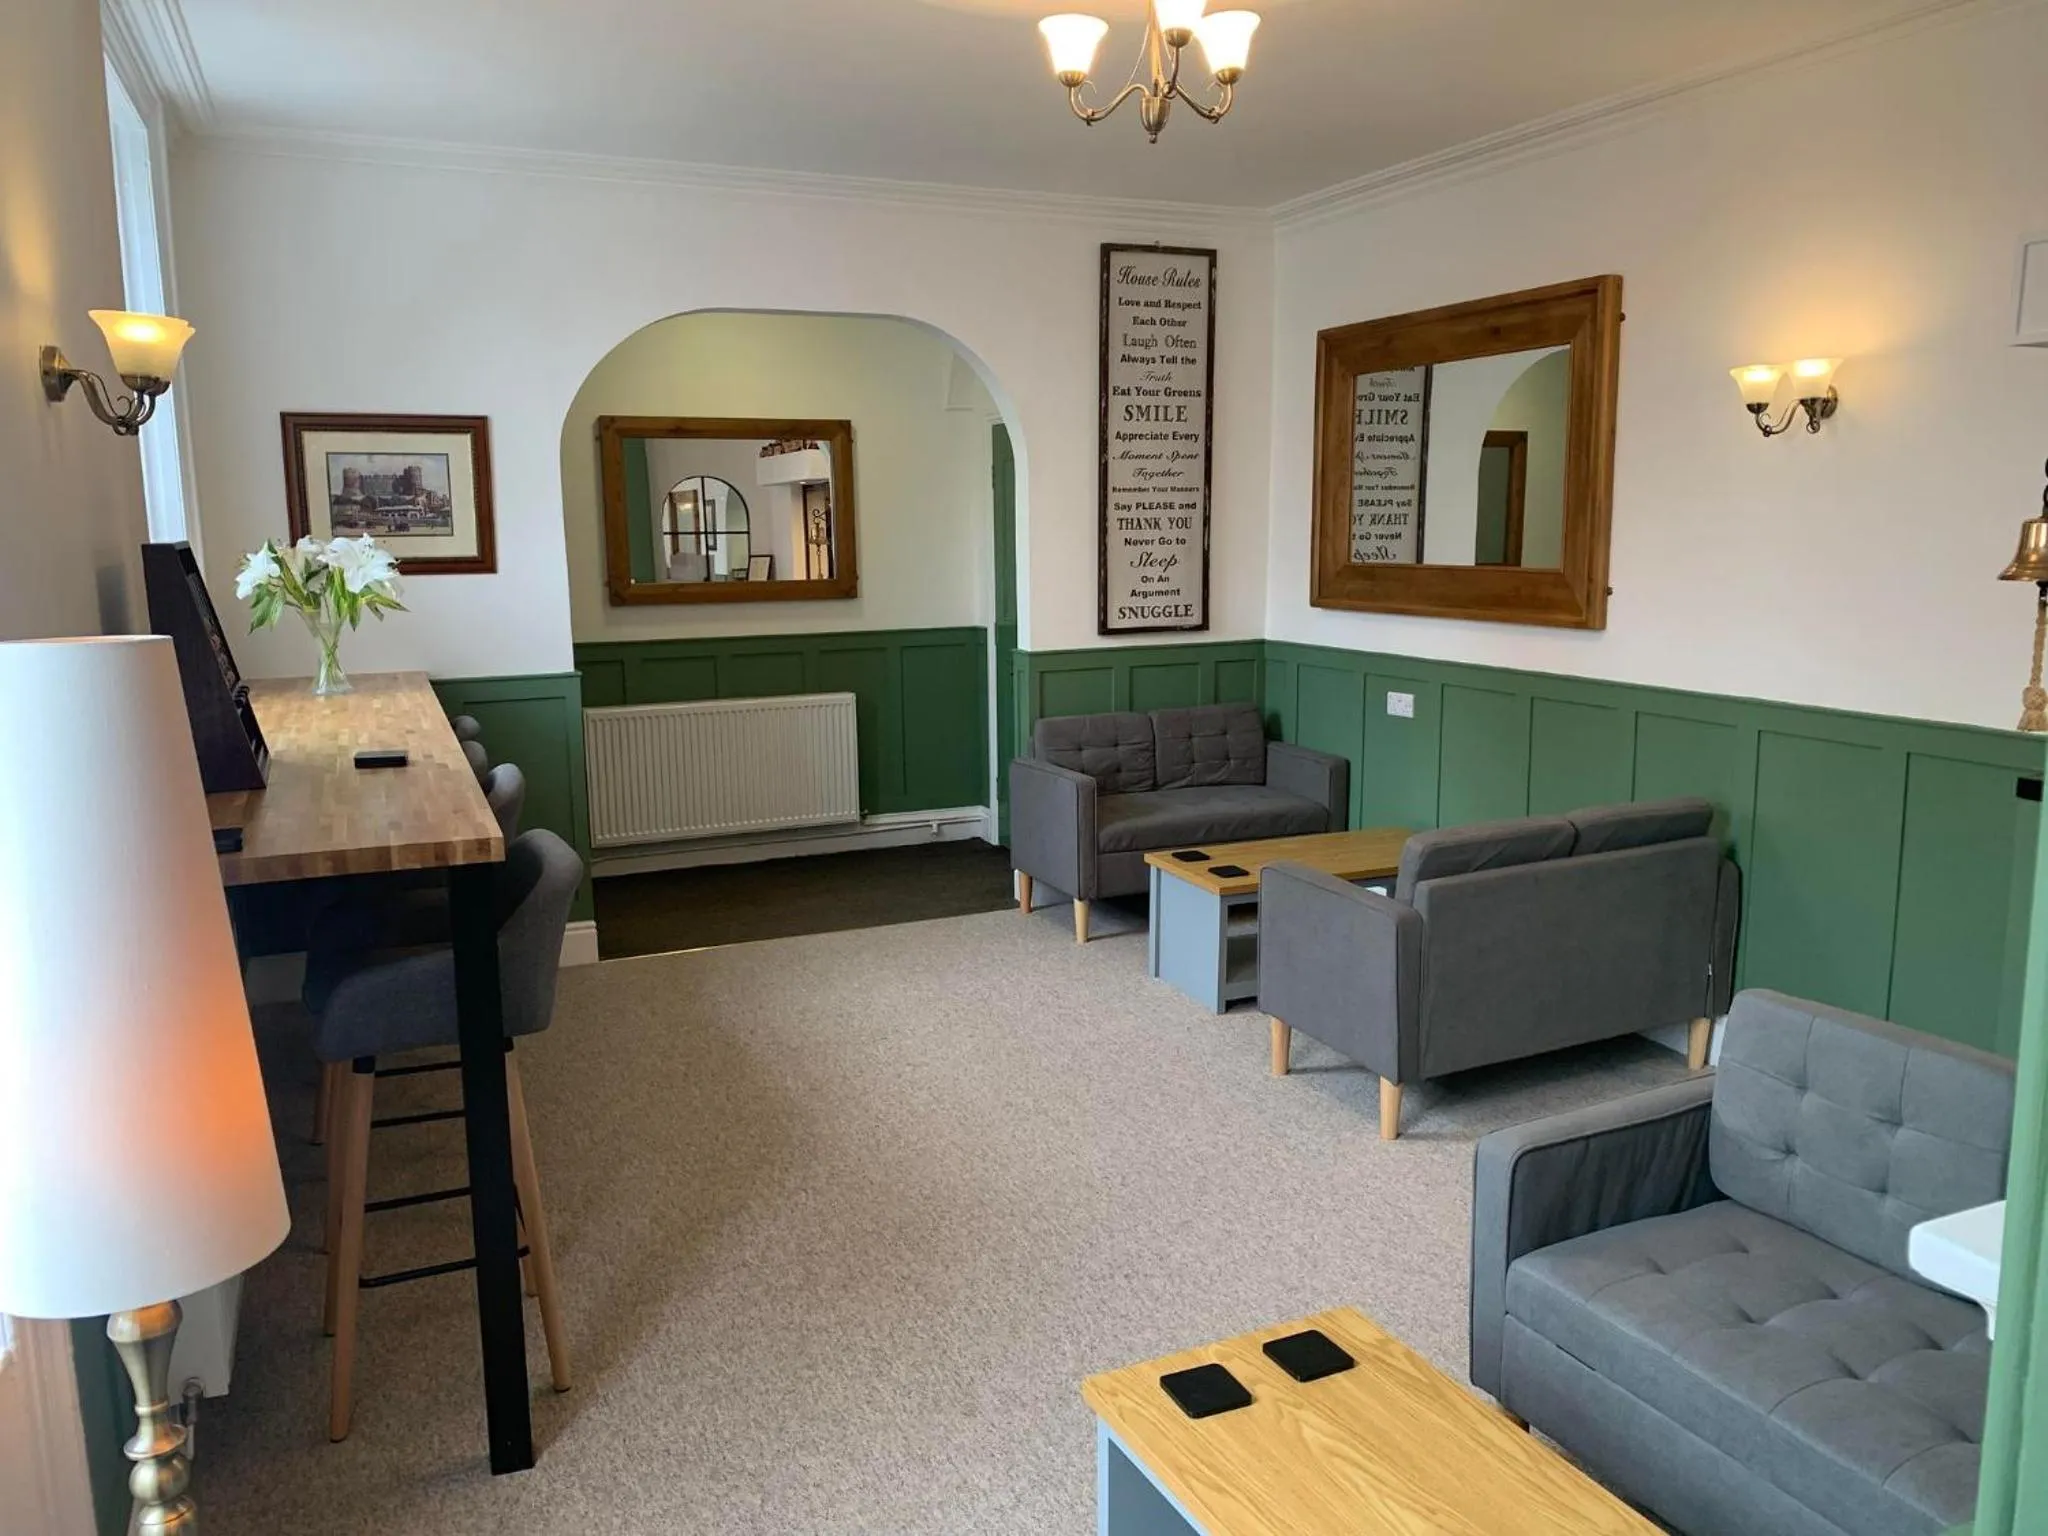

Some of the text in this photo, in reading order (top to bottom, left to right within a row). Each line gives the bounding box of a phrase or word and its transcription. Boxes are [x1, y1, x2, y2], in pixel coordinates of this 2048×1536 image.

[1117, 265, 1200, 288] House Rules
[1118, 297, 1202, 310] Love and Respect
[1132, 316, 1187, 326] Each Other
[1123, 334, 1196, 350] Laugh Often
[1120, 354, 1197, 365] Always Tell the
[1140, 371, 1172, 382] Truth
[1112, 386, 1202, 397] Eat Your Greens
[1123, 404, 1188, 422] SMILE
[1115, 432, 1200, 442] Appreciate Every
[1112, 450, 1199, 463] Moment Spent
[1132, 468, 1184, 480] Together
[1114, 502, 1196, 512] Say PLEASE and
[1117, 516, 1192, 530] THANK YOU
[1124, 536, 1186, 546] Never Go to
[1130, 552, 1178, 572] Sleep
[1141, 576, 1154, 584] On
[1130, 588, 1180, 598] Argument
[1118, 604, 1194, 620] SNUGGLE
